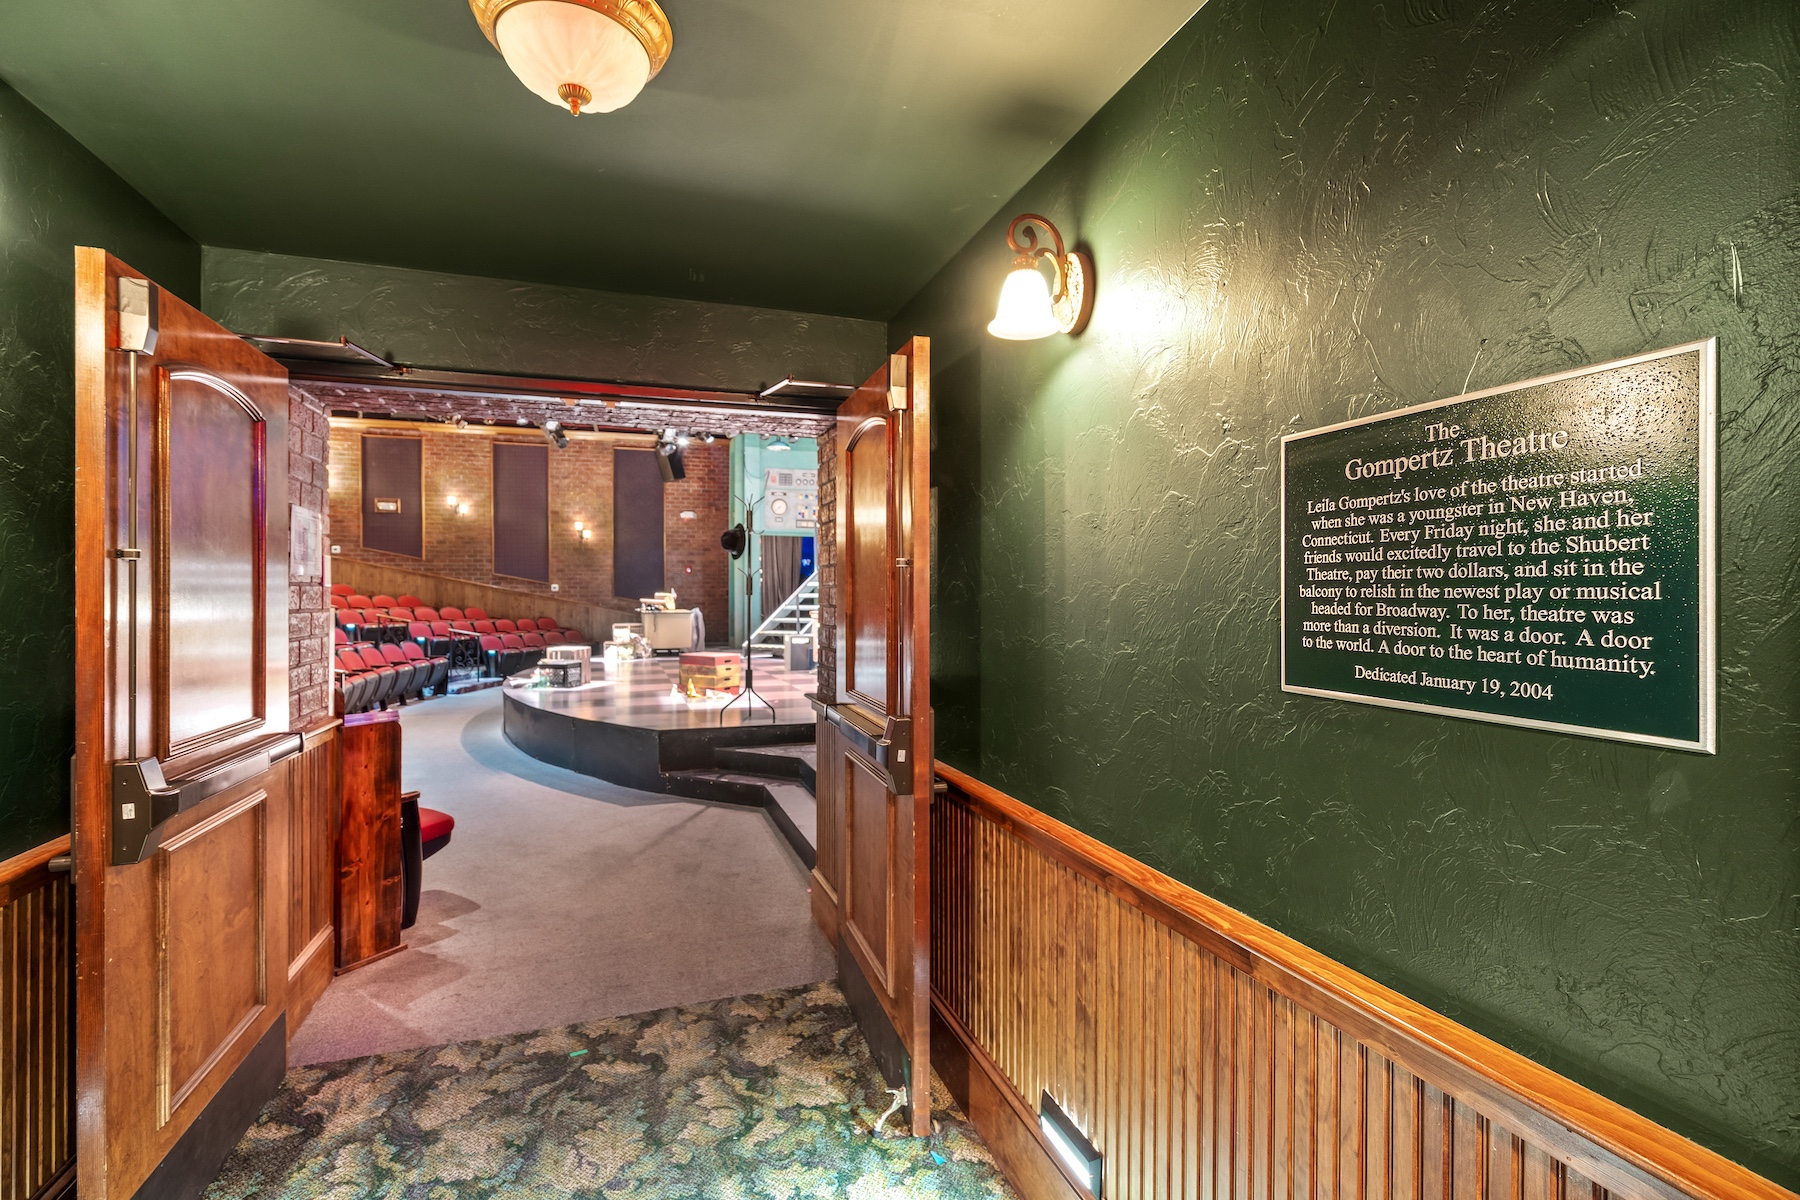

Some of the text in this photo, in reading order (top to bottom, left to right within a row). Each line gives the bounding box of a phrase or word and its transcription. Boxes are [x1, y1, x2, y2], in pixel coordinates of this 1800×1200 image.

[1424, 421, 1460, 443] The
[1345, 429, 1569, 481] Gompertz Theatre
[1307, 459, 1643, 514] Leila Gompertz's love of the theatre started
[1311, 490, 1633, 530] when she was a youngster in New Haven,
[1301, 509, 1653, 547] Connecticut. Every Friday night, she and her
[1303, 534, 1650, 564] friends would excitedly travel to the Shubert
[1306, 558, 1644, 583] Theatre, pay their two dollars, and sit in the
[1298, 582, 1661, 604] balcony to relish in the newest play or musical
[1310, 601, 1634, 625] headed for Broadway. To her, theatre was
[1302, 619, 1653, 651] more than a diversion. It was a door. A door
[1301, 635, 1656, 679] to the world. A door to the heart of humanity.
[1354, 665, 1553, 701] Dedicated January 19, 2004
